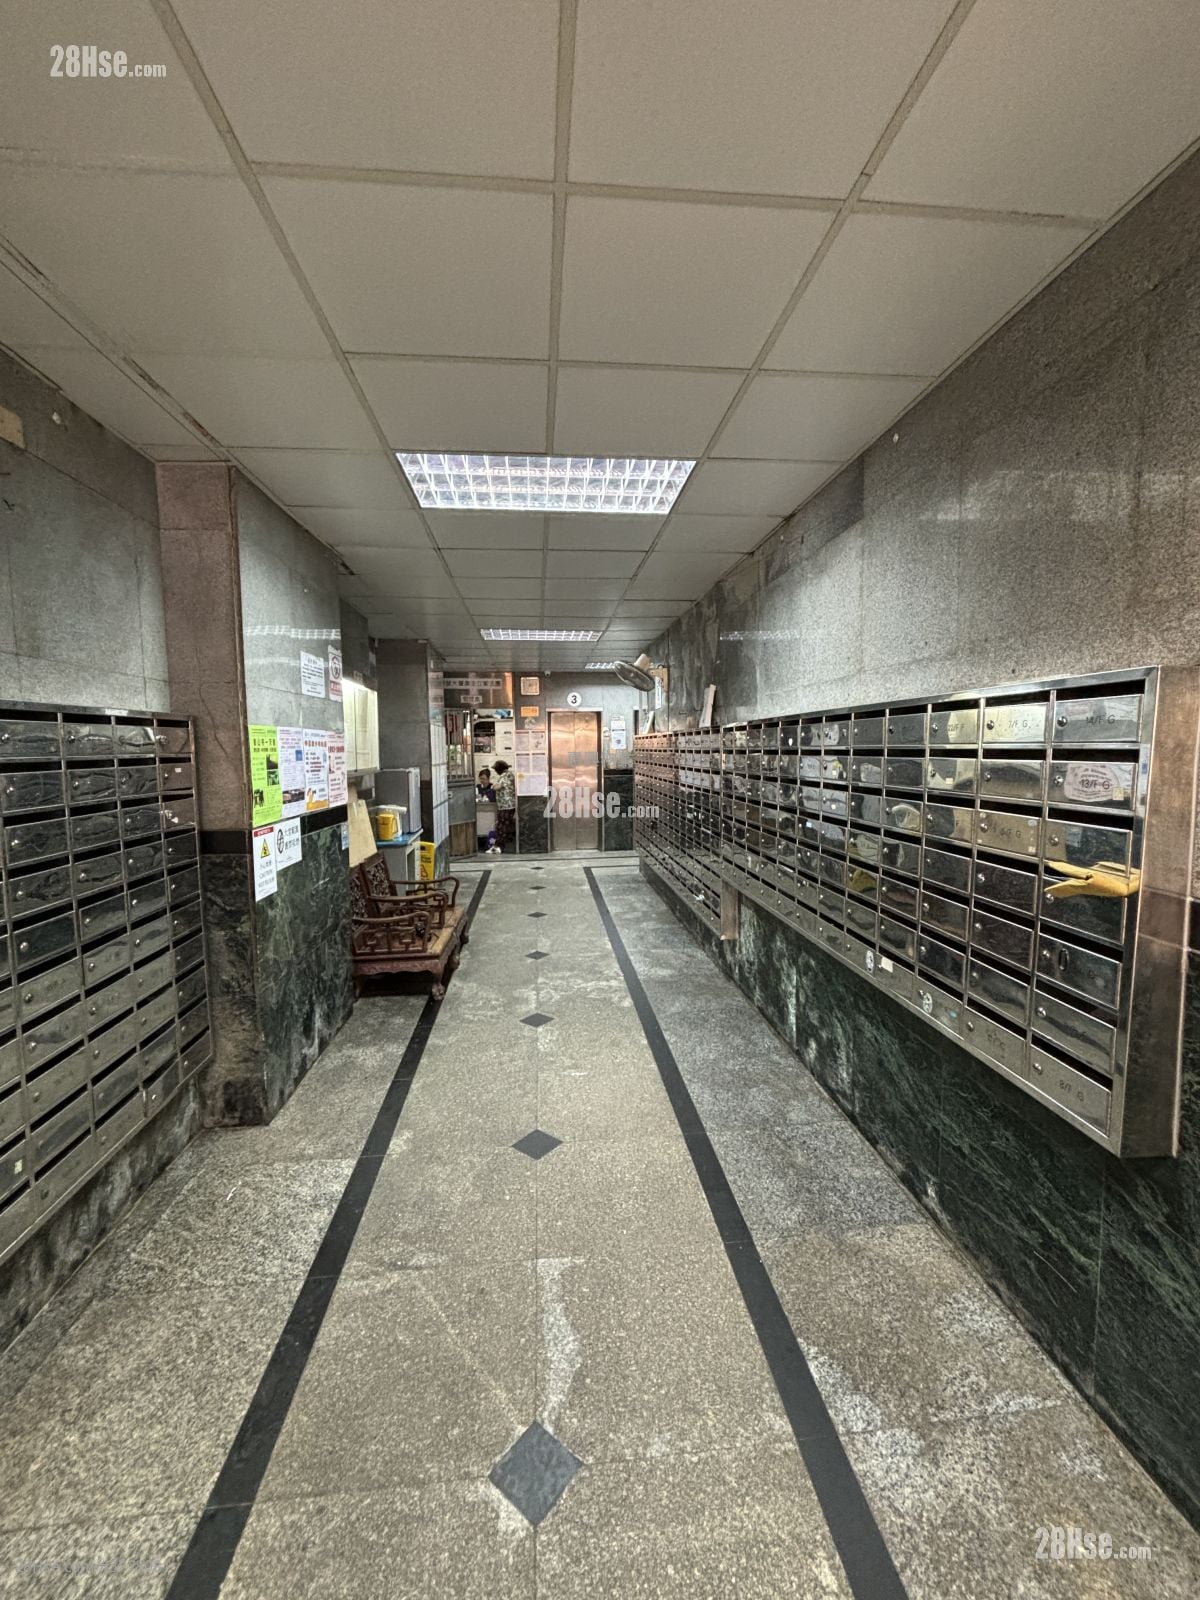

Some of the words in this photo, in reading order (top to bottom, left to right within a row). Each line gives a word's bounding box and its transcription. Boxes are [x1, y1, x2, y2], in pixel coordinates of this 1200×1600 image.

[571, 695, 577, 704] 3
[1107, 714, 1116, 724] G
[1080, 779, 1099, 788] 13/F
[1102, 780, 1110, 789] G
